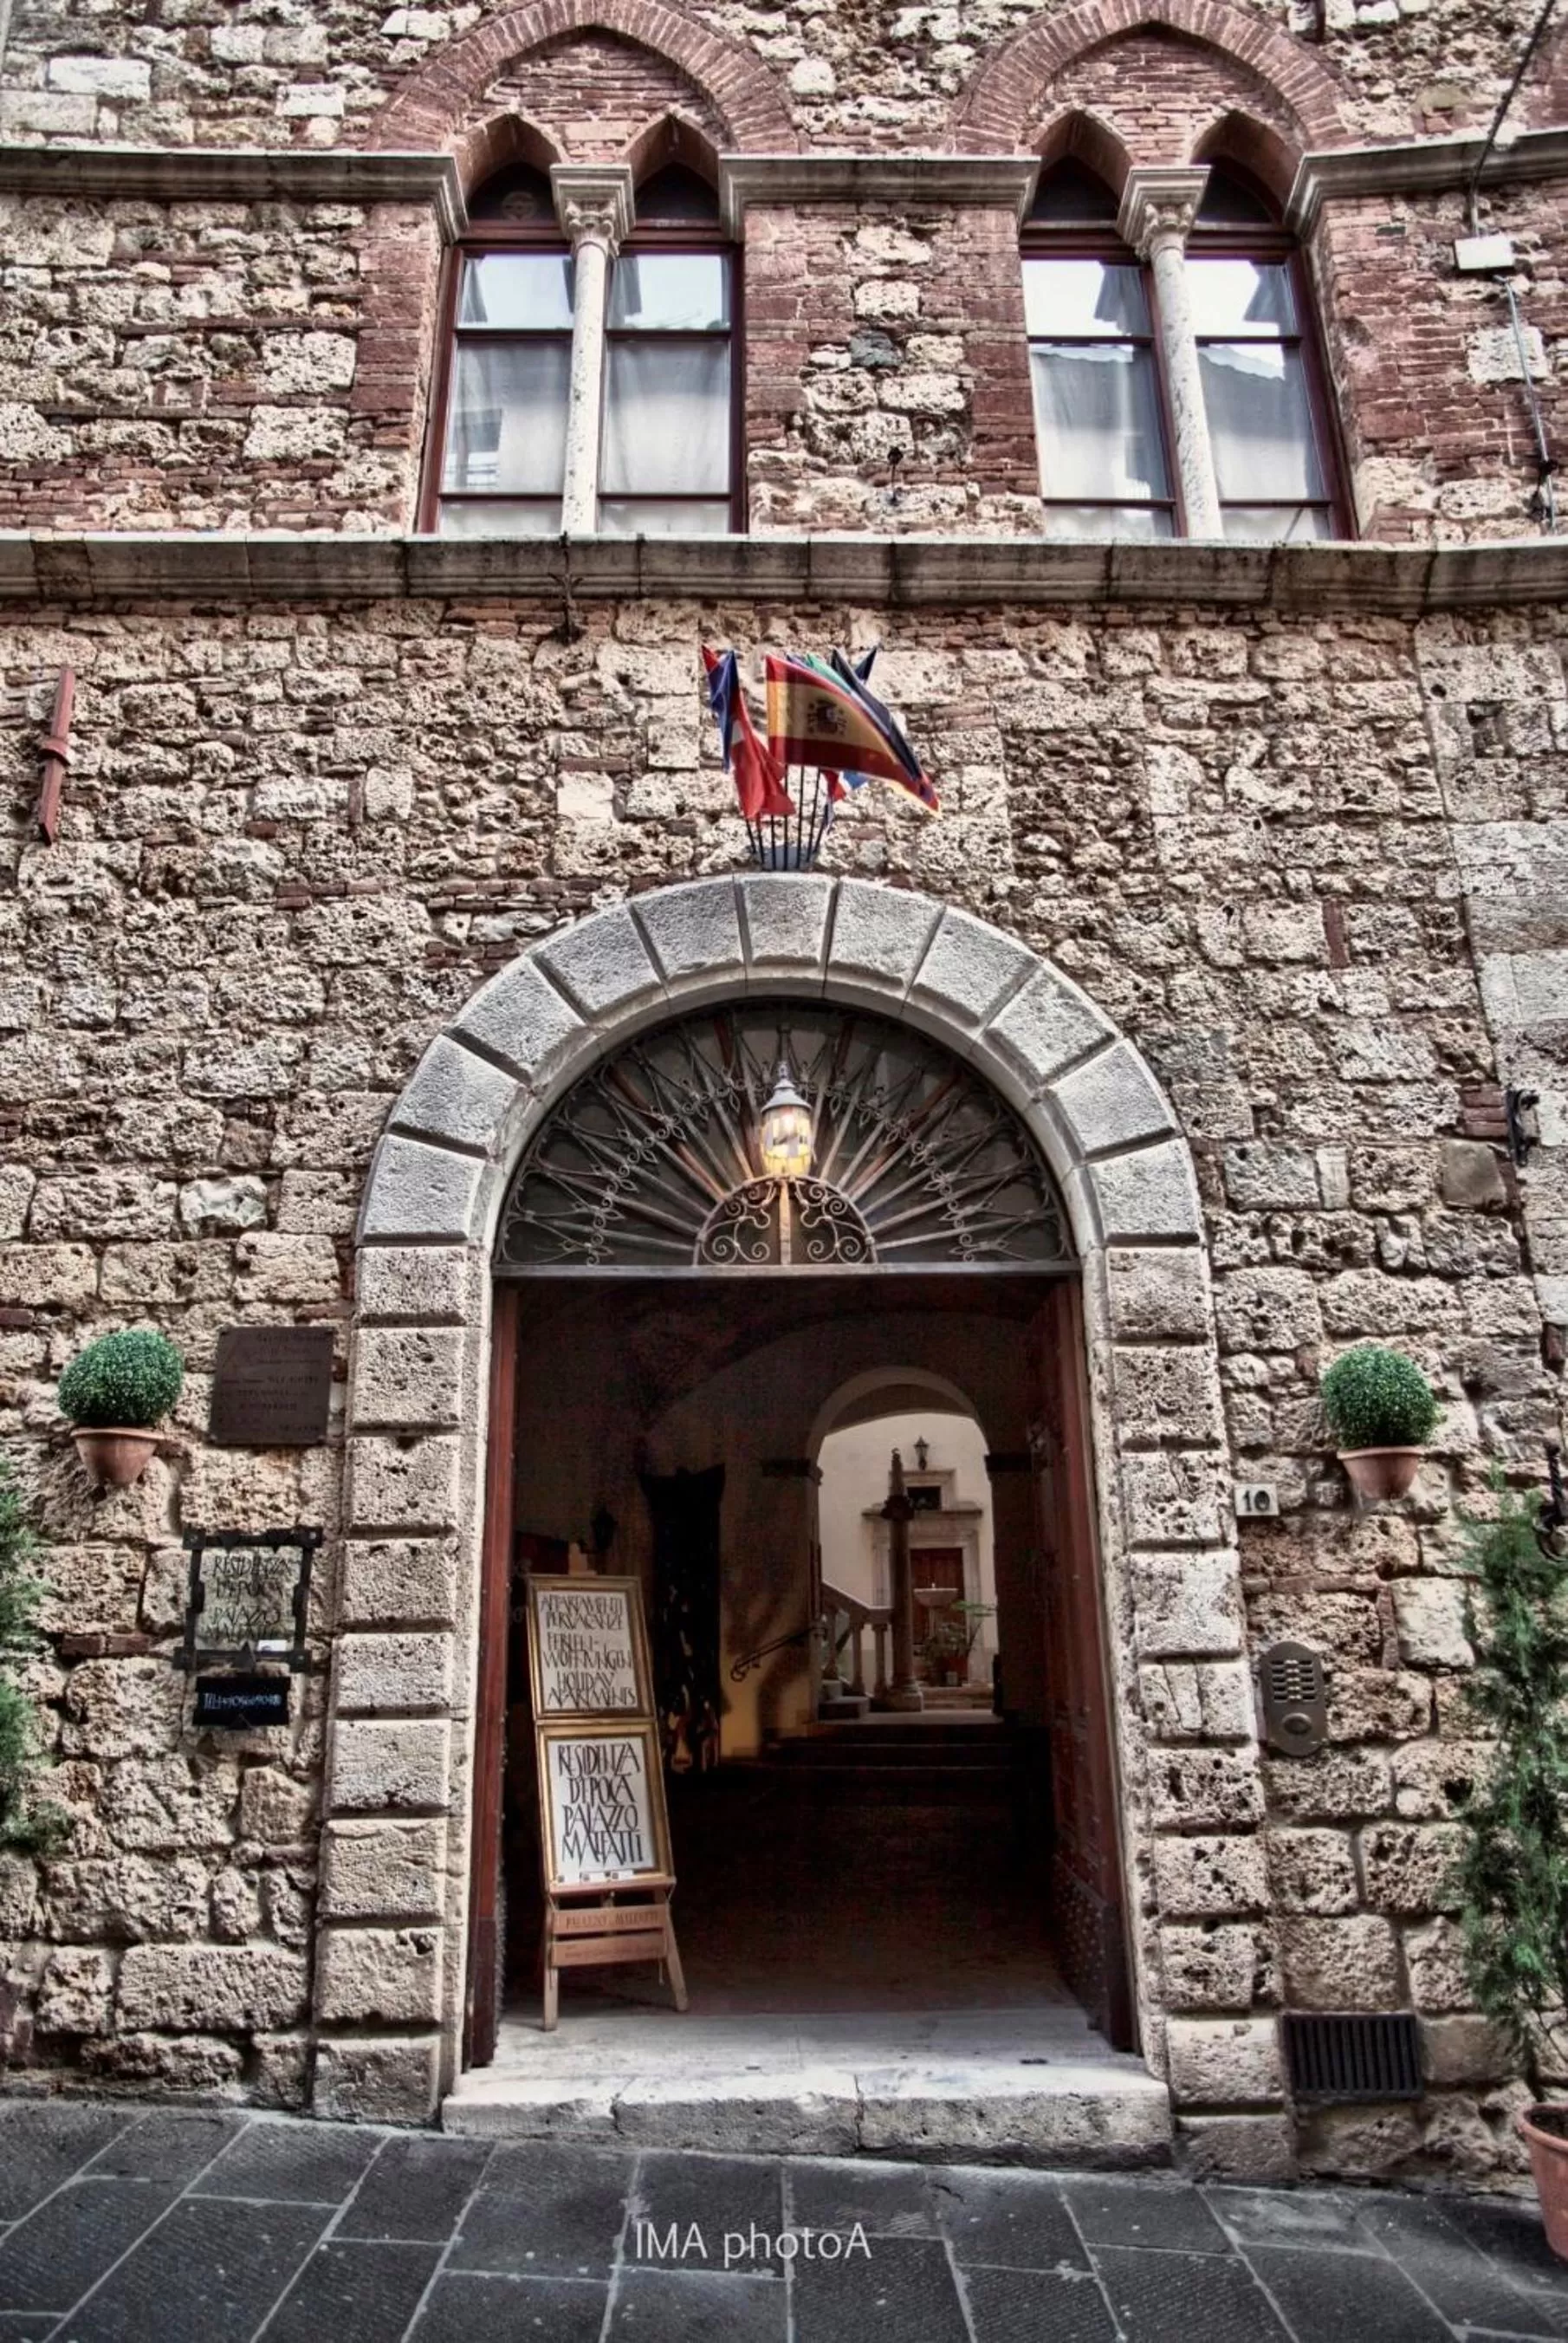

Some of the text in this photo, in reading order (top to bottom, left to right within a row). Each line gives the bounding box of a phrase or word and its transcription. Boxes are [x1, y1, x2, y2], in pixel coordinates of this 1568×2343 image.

[1242, 1490, 1270, 1513] 10
[548, 1686, 637, 1708] APARTMENTS
[557, 1669, 616, 1695] HOLIDAY
[557, 1743, 641, 1776] RESIDENZA
[567, 1775, 636, 1807] D'EPOCA
[561, 1801, 641, 1836] PALAZZO
[561, 1830, 643, 1866] MALFATTI
